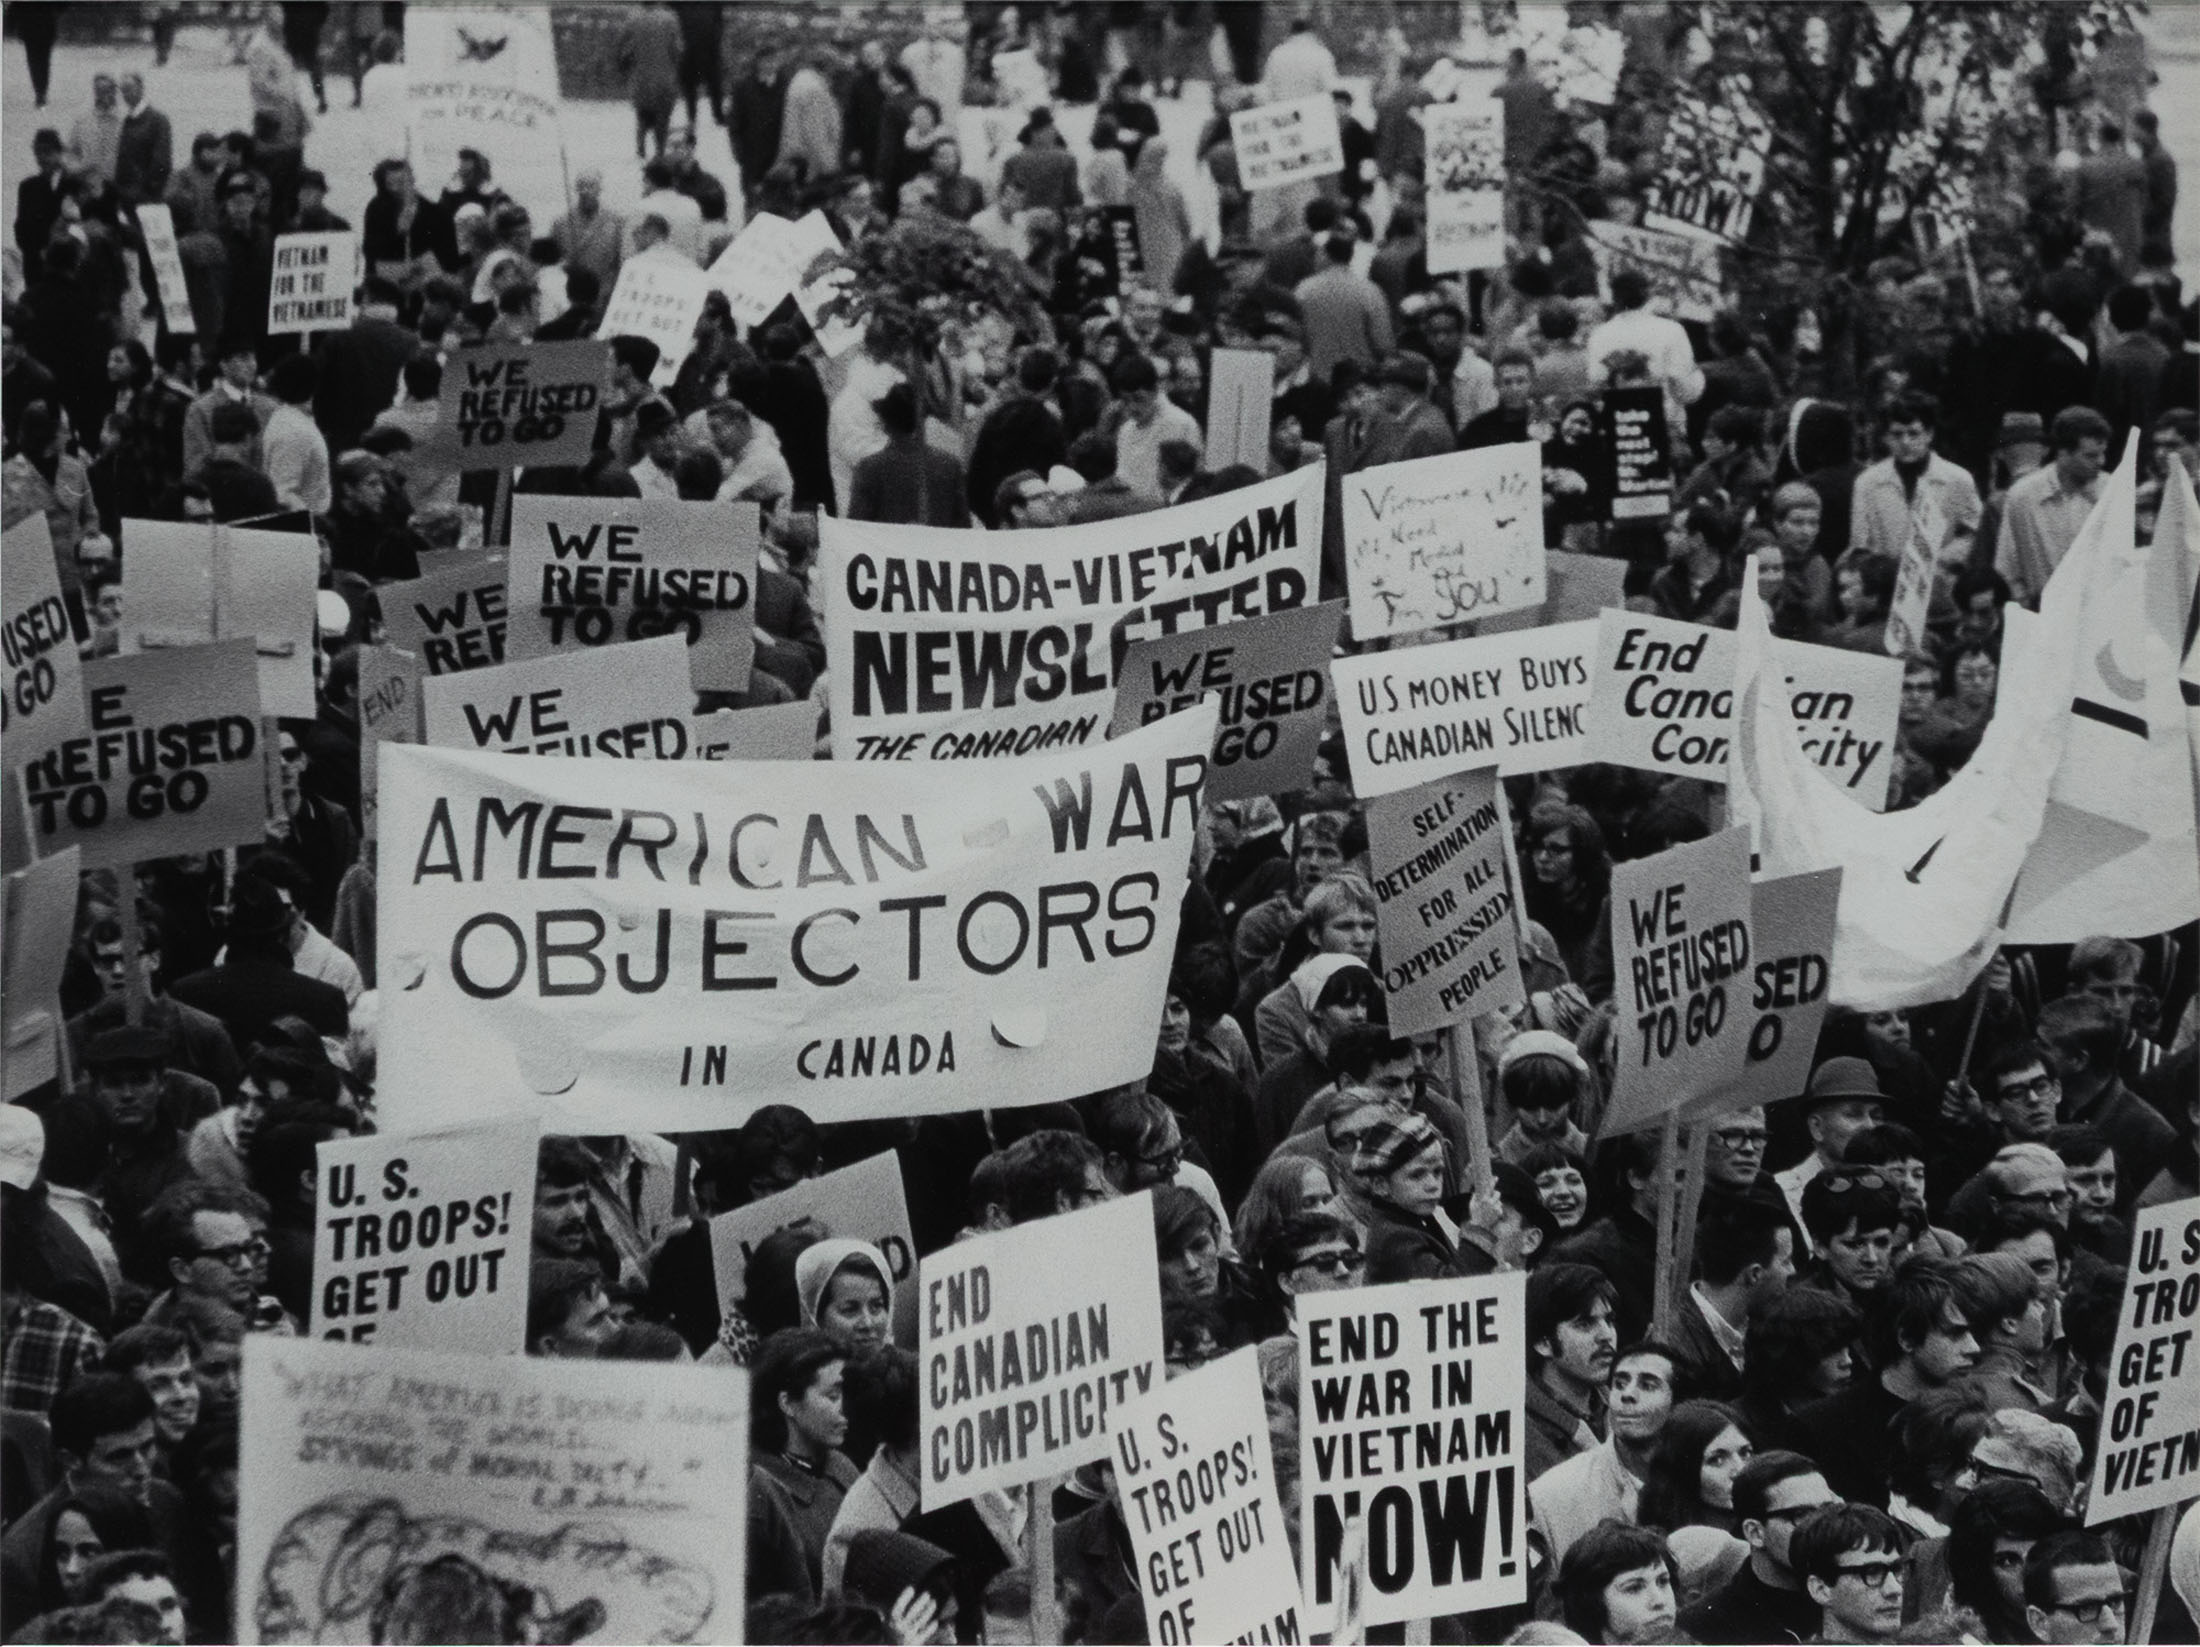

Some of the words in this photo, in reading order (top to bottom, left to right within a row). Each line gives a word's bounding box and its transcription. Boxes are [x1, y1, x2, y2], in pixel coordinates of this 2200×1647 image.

[460, 383, 598, 422] REFUSED
[467, 360, 528, 387] WE
[458, 421, 504, 448] TO
[514, 415, 566, 444] GO
[547, 522, 643, 562] WE
[846, 499, 1298, 613] CANADA-VIETNAM
[414, 584, 508, 633] WE
[541, 564, 750, 611] REFUSED
[540, 606, 612, 647] TO
[1613, 628, 1709, 673] End
[16, 658, 55, 716] GO
[363, 675, 406, 727] END
[1152, 647, 1235, 696] WE
[1408, 668, 1502, 709] MONEY
[1519, 655, 1588, 692] BUYS
[463, 689, 569, 746] WE
[856, 733, 926, 760] THE
[931, 714, 1098, 760] CANADIAN
[1213, 720, 1279, 766] GO
[1366, 715, 1494, 766] CANADIAN
[26, 714, 255, 790] REFUSED
[28, 784, 107, 834] TO
[127, 769, 209, 820] GO
[413, 796, 928, 889] AMERICAN
[1033, 755, 1206, 853] WAR
[1375, 801, 1500, 903] DETERMINATION
[1418, 888, 1458, 928] FOR
[1464, 858, 1496, 895] ALL
[1629, 883, 1687, 948] WE
[450, 870, 1162, 999] OBJECTORS
[1384, 891, 1513, 994] OPPRESSED
[1631, 919, 1750, 1013] REFUSED
[1438, 947, 1507, 1013] PEOPLE
[680, 1044, 728, 1086] IN
[797, 1030, 956, 1080] CANADA
[1637, 1005, 1678, 1067] TO
[1685, 985, 1727, 1047] GO
[327, 1191, 512, 1262] TROOPS!
[322, 1265, 410, 1319] GET
[425, 1248, 506, 1304] OUT
[929, 1264, 991, 1340] END
[930, 1302, 1111, 1411] CANADIAN
[1308, 1312, 1399, 1368] END
[1419, 1297, 1499, 1354] THE
[2118, 1330, 2193, 1390] GET
[1311, 1369, 1411, 1425] WAR
[1431, 1359, 1472, 1410] IN
[2110, 1391, 2160, 1443] OF
[1312, 1410, 1512, 1483] VIETNAM
[1131, 1434, 1258, 1534] TROOPS!
[1148, 1529, 1205, 1598] GET
[1217, 1498, 1265, 1563] OUT
[1313, 1465, 1517, 1605] NOW!
[1158, 1598, 1196, 1646] OF
